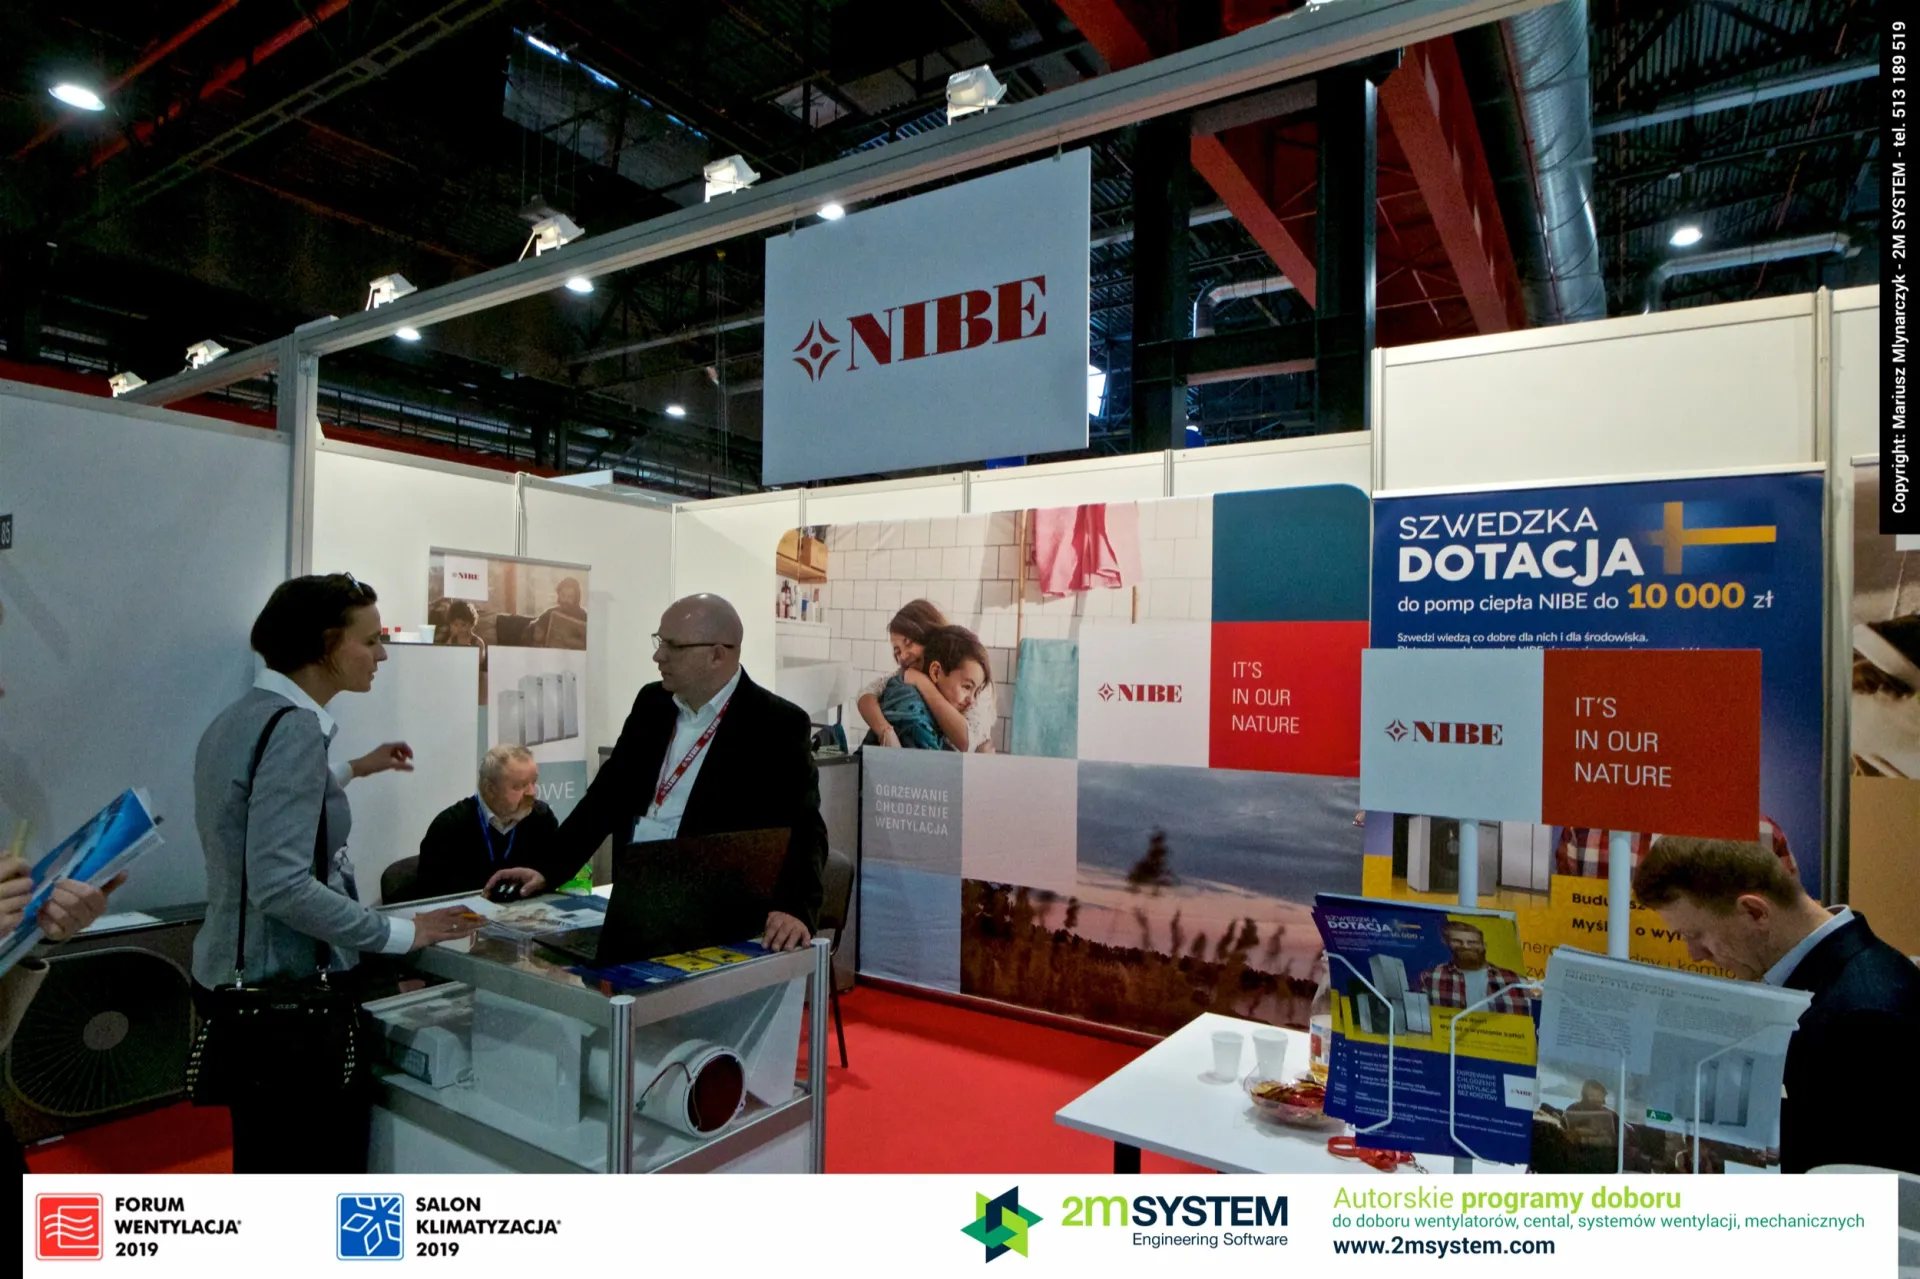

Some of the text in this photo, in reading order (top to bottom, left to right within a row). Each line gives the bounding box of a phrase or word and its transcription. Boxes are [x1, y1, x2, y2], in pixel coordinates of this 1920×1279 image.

[846, 274, 1047, 372] NIBE
[1399, 506, 1599, 540] SZWEDZKA
[1398, 537, 1645, 587] DOTACJA
[1397, 582, 1774, 615] do pomp ciepła NIBE do 10 000 zł
[1397, 631, 1649, 644] Szwedzi wiedzą co dobre dla nich i dla środowiska.
[1232, 661, 1263, 679] IT'S
[1117, 684, 1183, 703] NIBE
[1232, 688, 1291, 706] IN OUR
[1574, 696, 1617, 719] IT'S
[1232, 714, 1300, 734] NATURE
[1412, 720, 1504, 746] NIBE
[1574, 729, 1659, 754] IN OUR
[1574, 761, 1672, 788] NATURE
[875, 783, 949, 802] OGRZEWANIE
[875, 800, 949, 819] CHŁODZENIE
[875, 815, 948, 836] WENTYLACJA
[1327, 920, 1393, 932] DOTACJA
